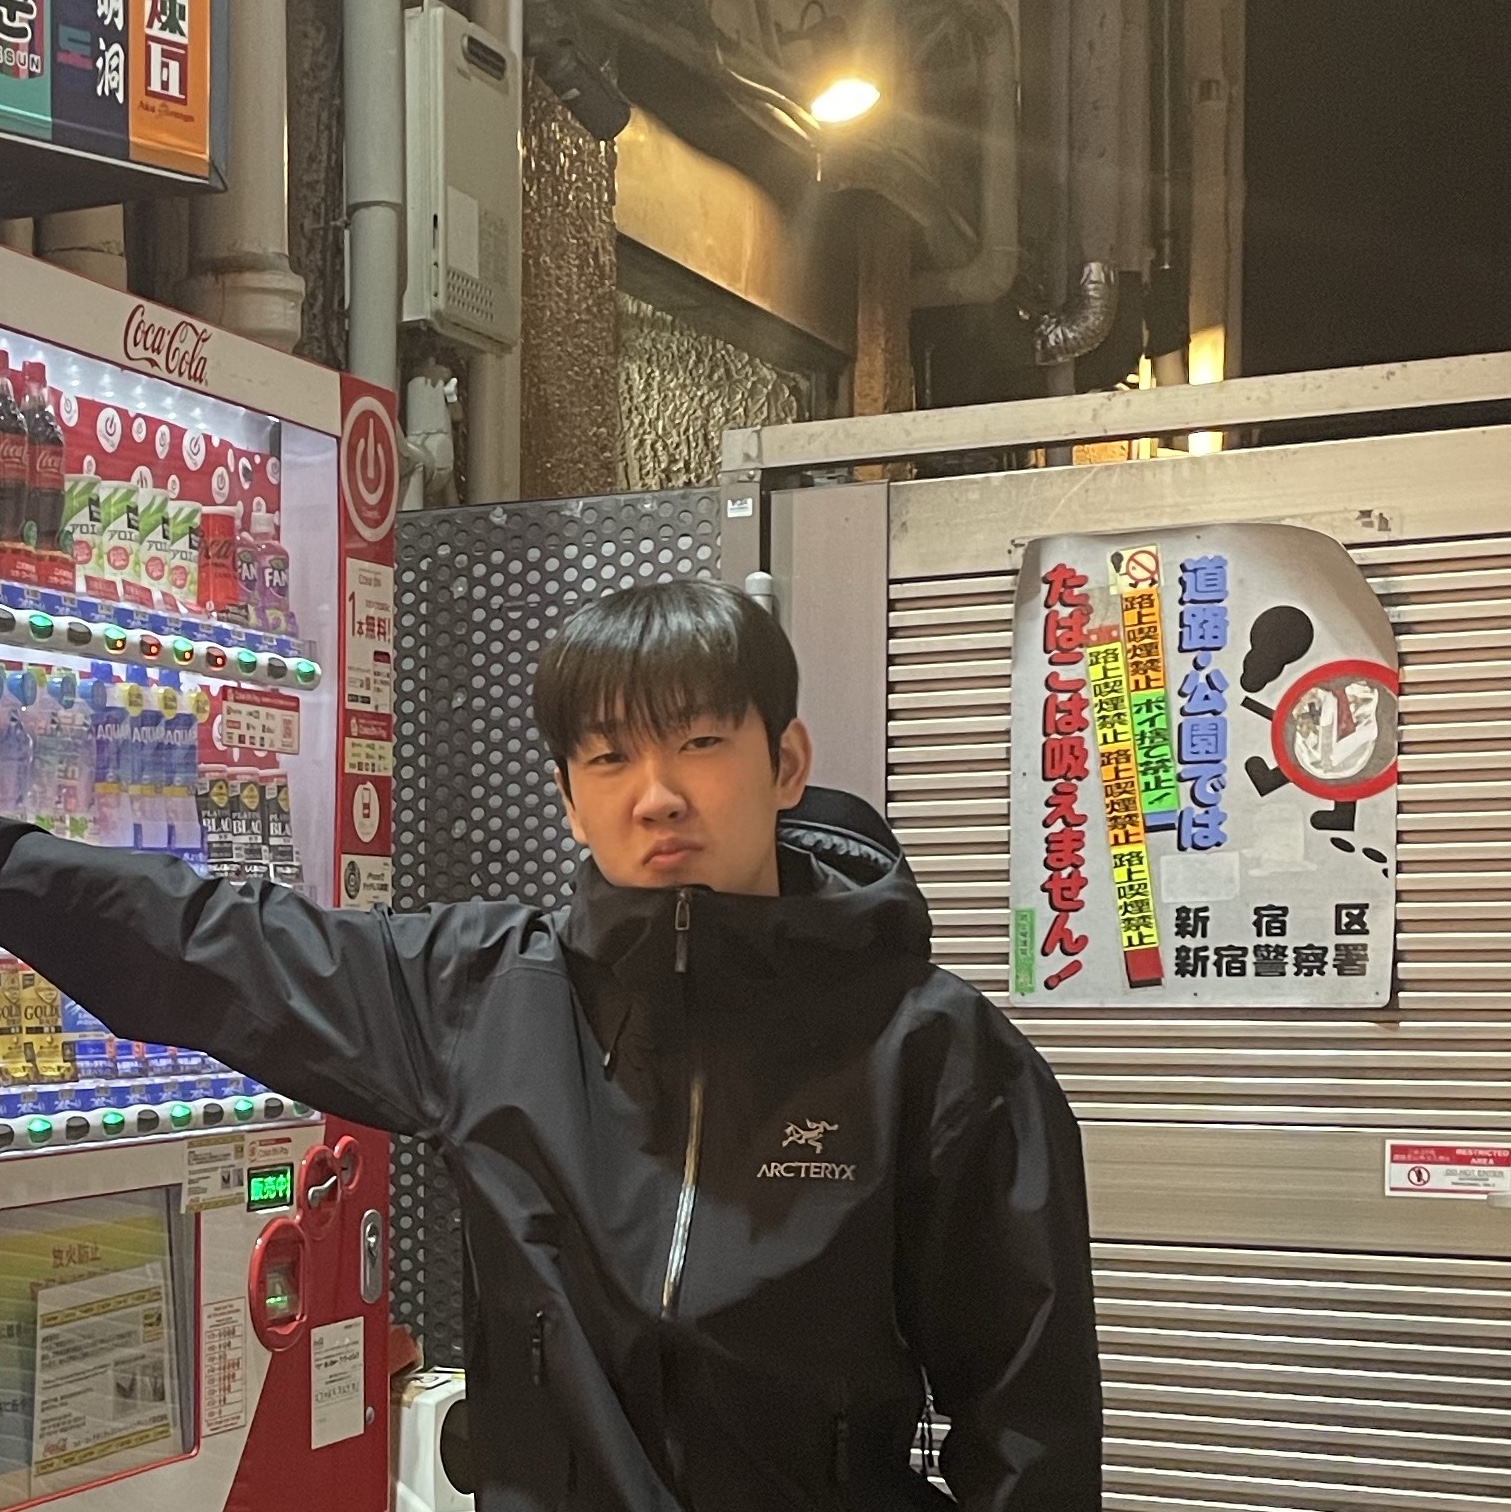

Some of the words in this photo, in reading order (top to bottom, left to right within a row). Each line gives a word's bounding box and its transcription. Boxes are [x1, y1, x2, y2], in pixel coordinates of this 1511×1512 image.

[123, 303, 213, 386] Coca-Cola
[1122, 592, 1166, 694] 路上喫煙禁止
[1087, 646, 1130, 746] 路上喫煙禁止
[1177, 554, 1230, 853] 道路・公園では
[1040, 561, 1090, 990] たばこは吸えません!
[1099, 748, 1143, 845] 路上喫煙禁止
[1112, 850, 1156, 948] 路上喫煙禁止
[1174, 943, 1370, 979] 新宿警察署
[251, 1174, 289, 1203] 販売中
